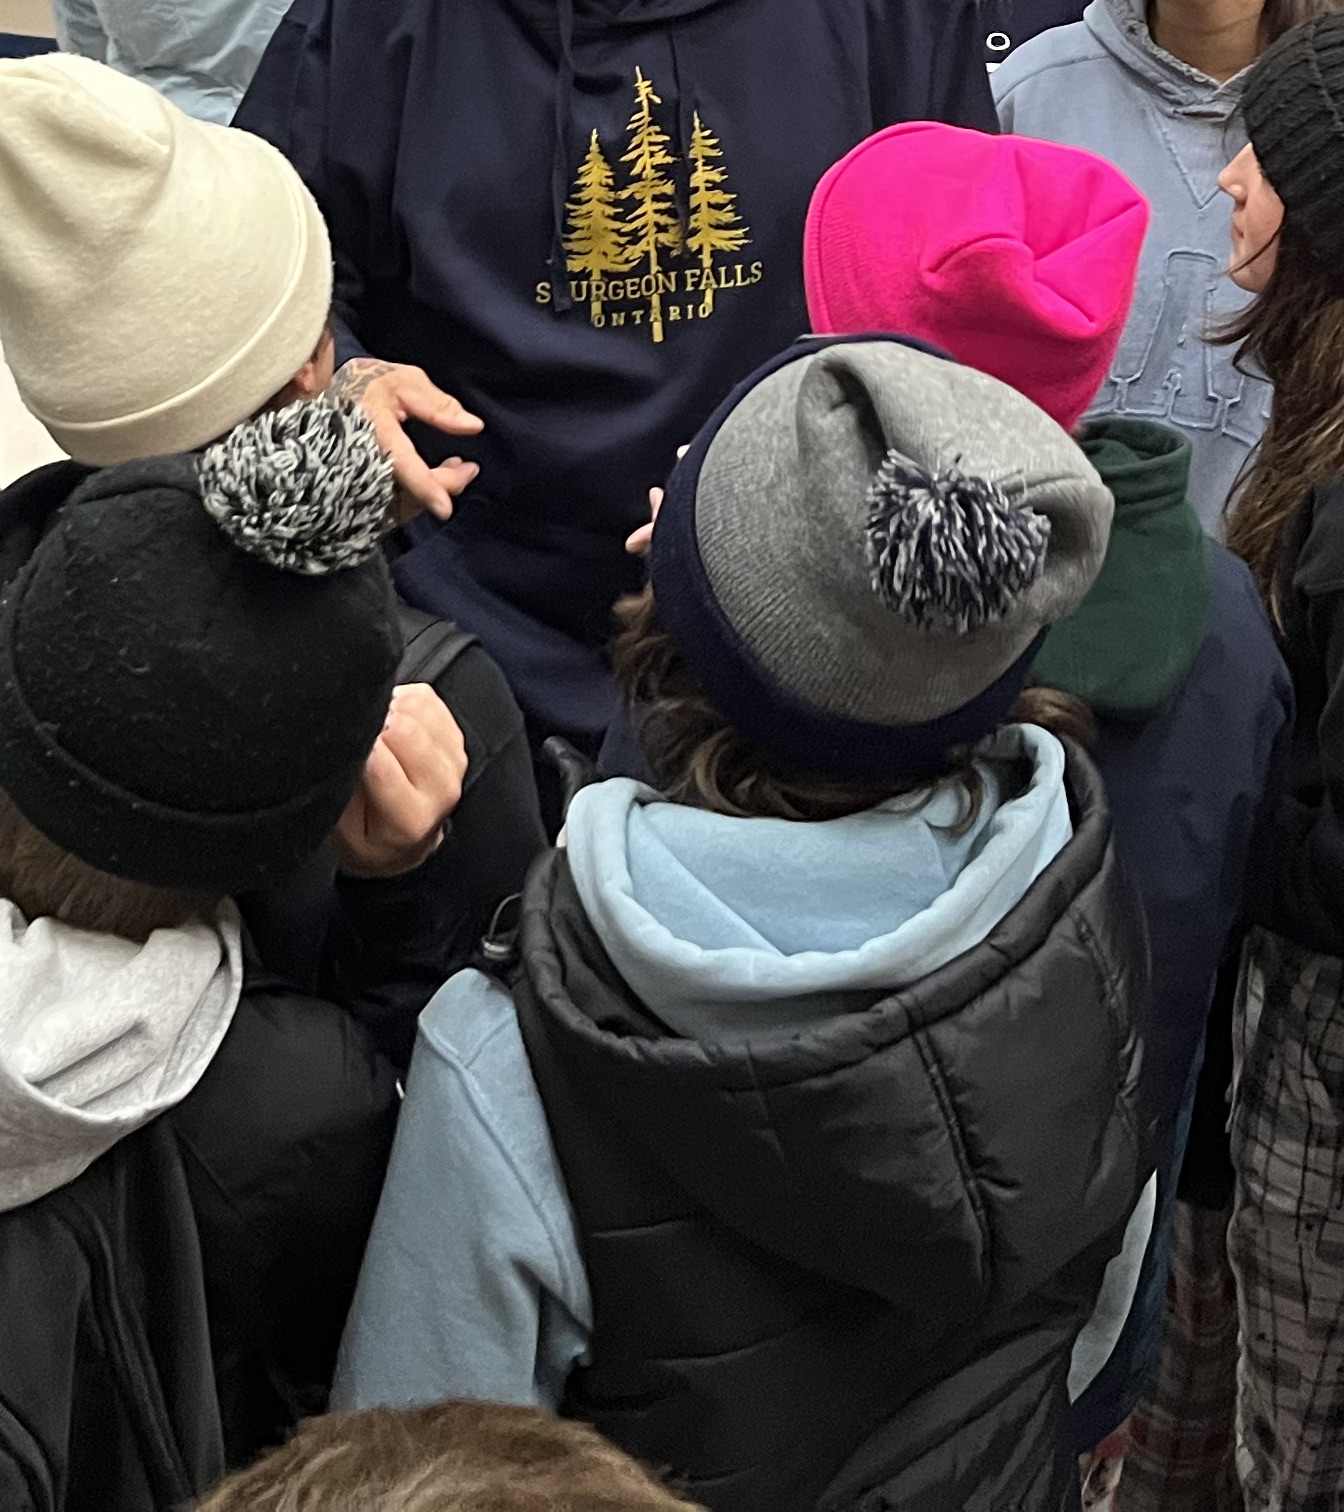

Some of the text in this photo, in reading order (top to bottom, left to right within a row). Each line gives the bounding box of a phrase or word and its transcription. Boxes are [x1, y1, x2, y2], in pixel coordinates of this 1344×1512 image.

[535, 261, 763, 305] SURGEON FALLS
[593, 303, 710, 328] ONTARIO
